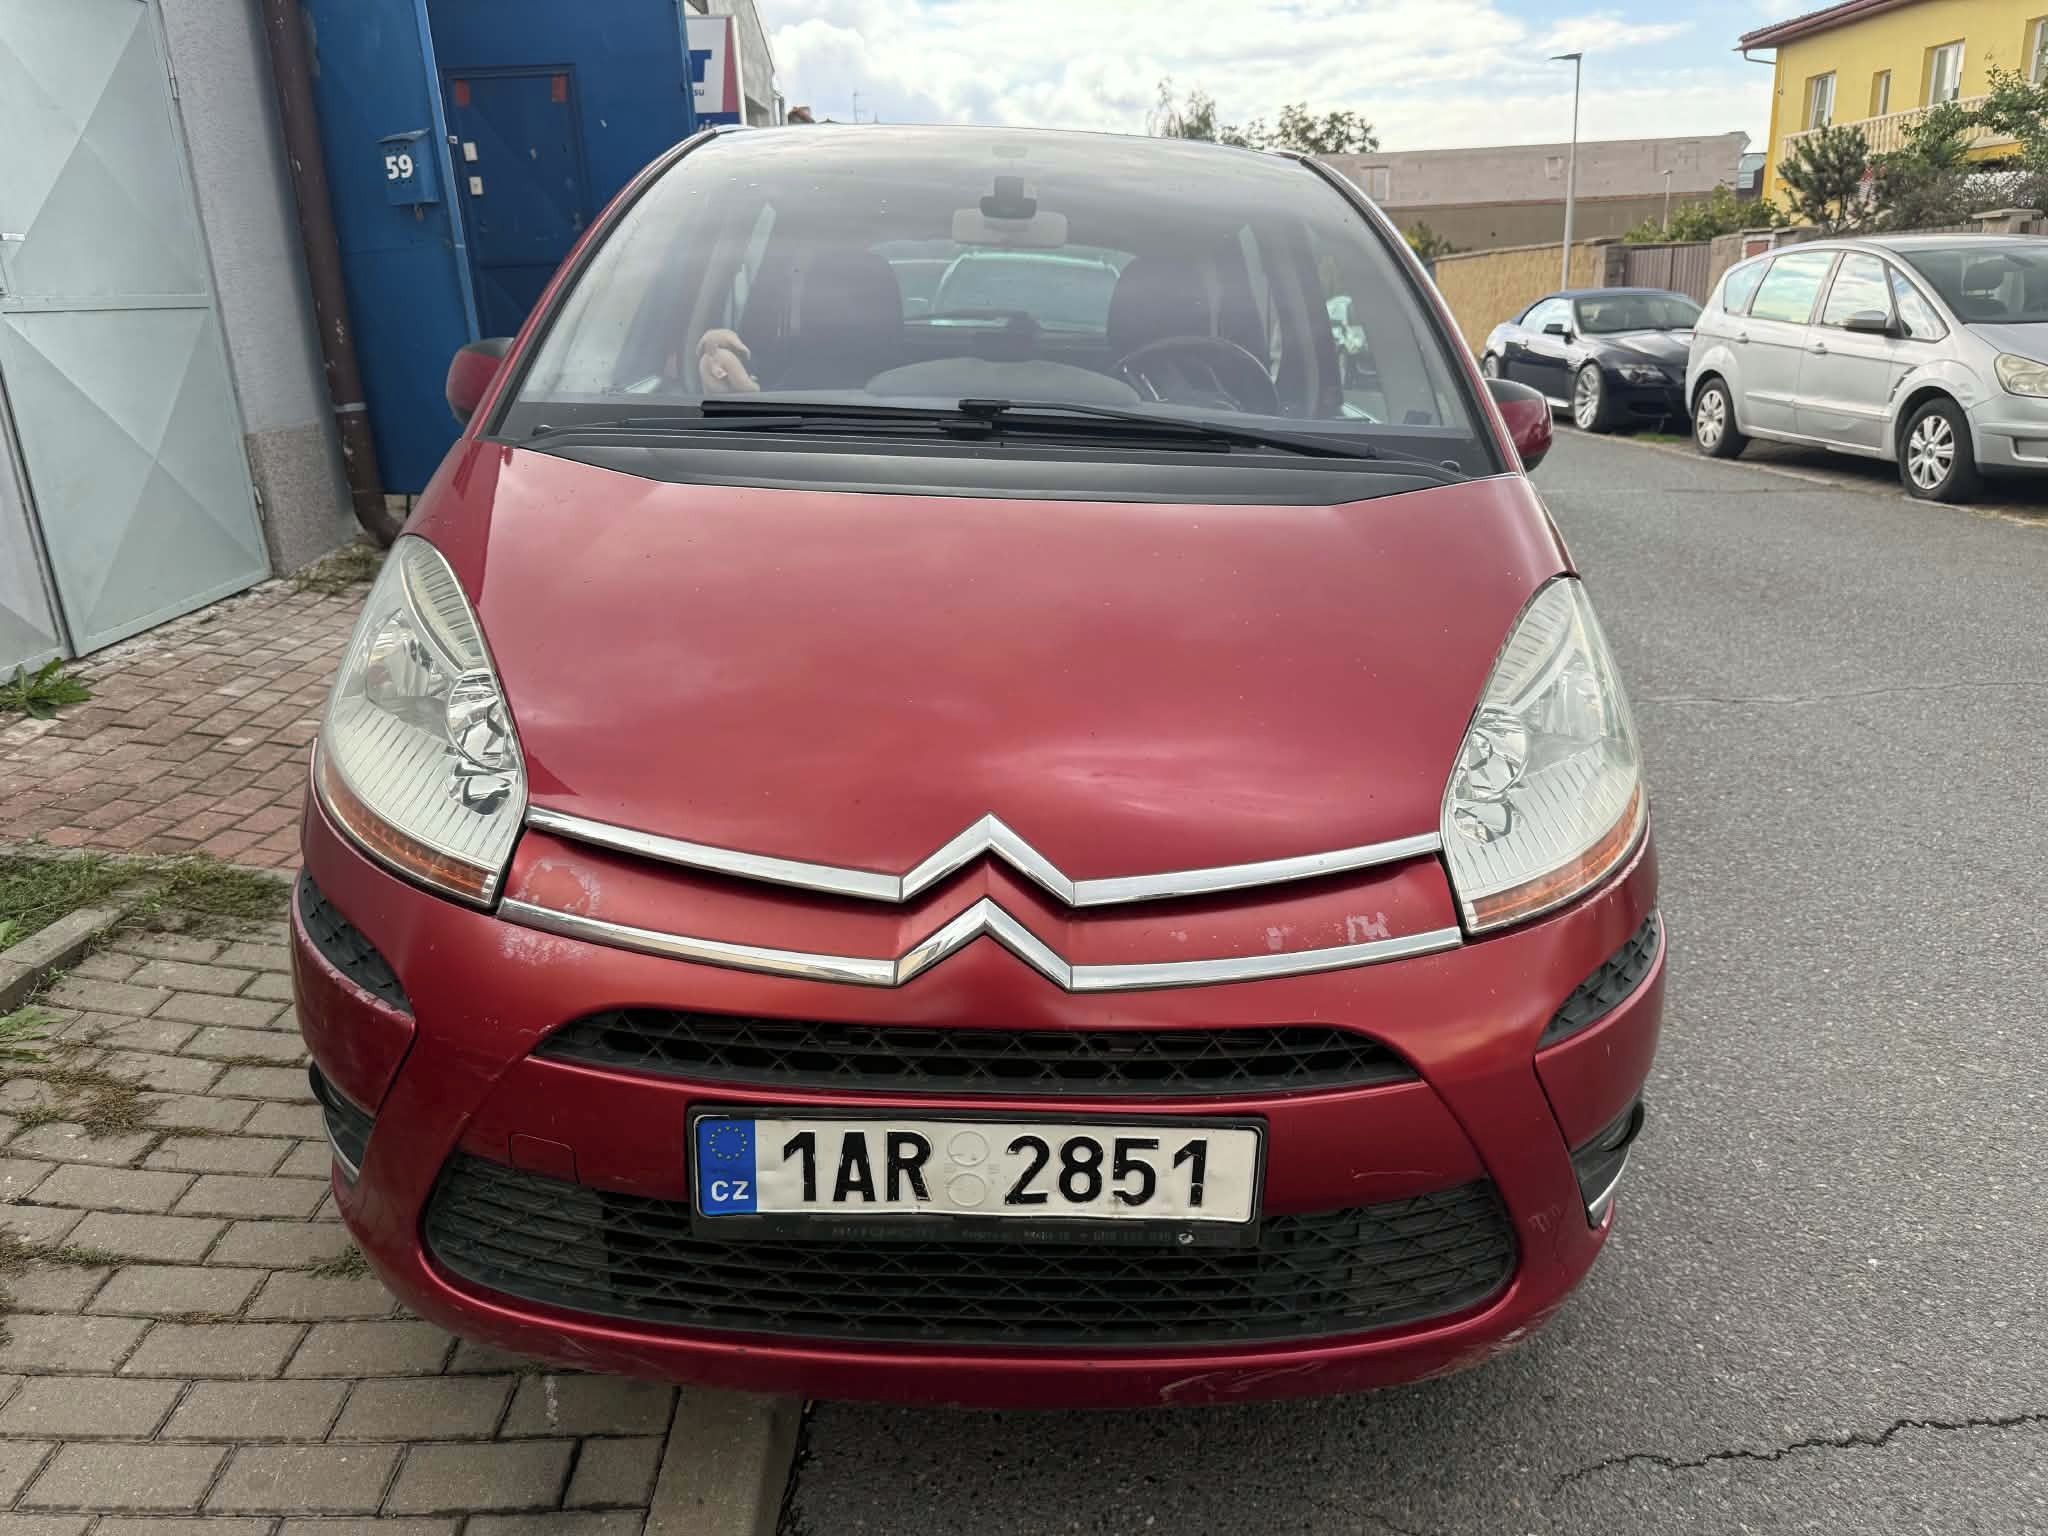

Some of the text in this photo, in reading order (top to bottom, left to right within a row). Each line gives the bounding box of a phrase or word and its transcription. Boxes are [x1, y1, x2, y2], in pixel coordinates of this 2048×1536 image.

[385, 154, 413, 180] 59
[783, 1131, 1208, 1207] 1AR 2851
[711, 1180, 749, 1201] CZ
